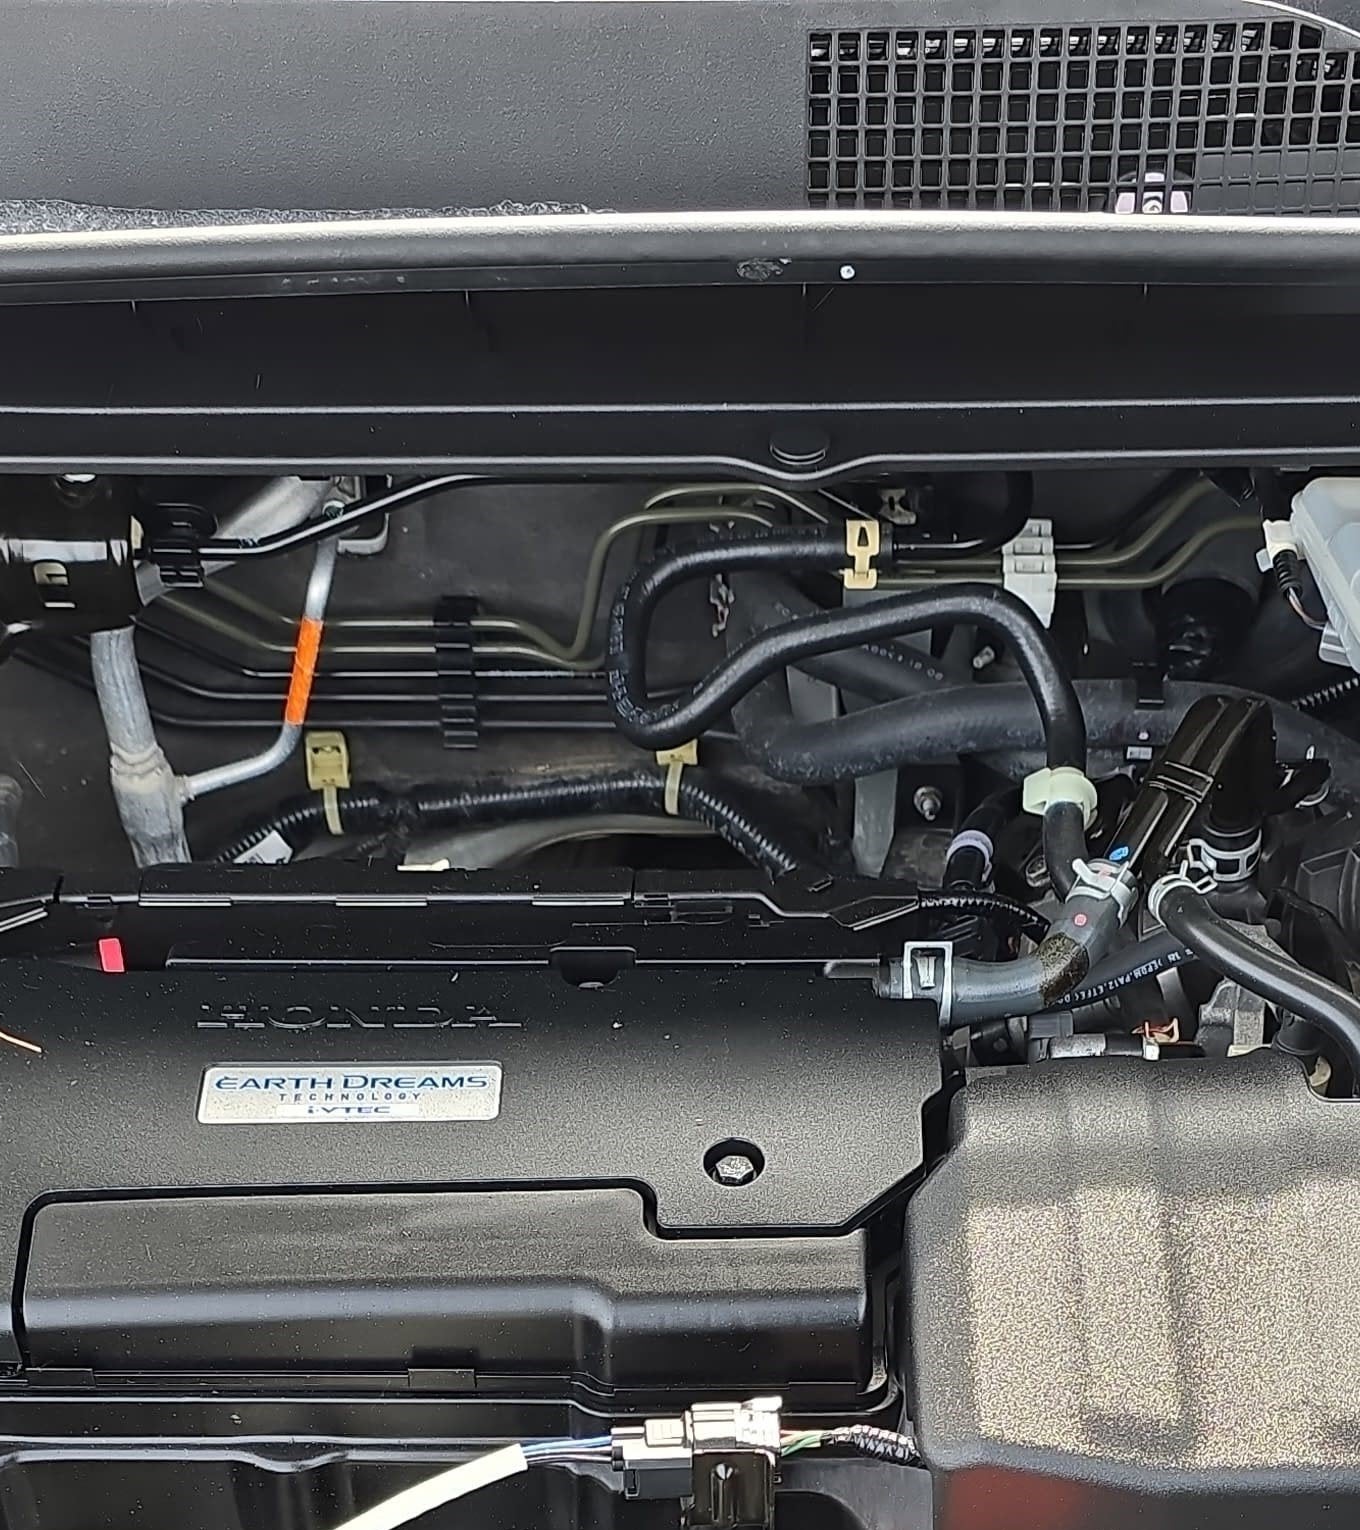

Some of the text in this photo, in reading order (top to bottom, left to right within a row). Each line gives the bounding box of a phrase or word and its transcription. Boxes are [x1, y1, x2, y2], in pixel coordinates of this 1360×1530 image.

[197, 1004, 522, 1029] HONDA
[215, 1074, 489, 1090] EARTH DREAMS
[279, 1092, 421, 1101] TECHNOLOGY
